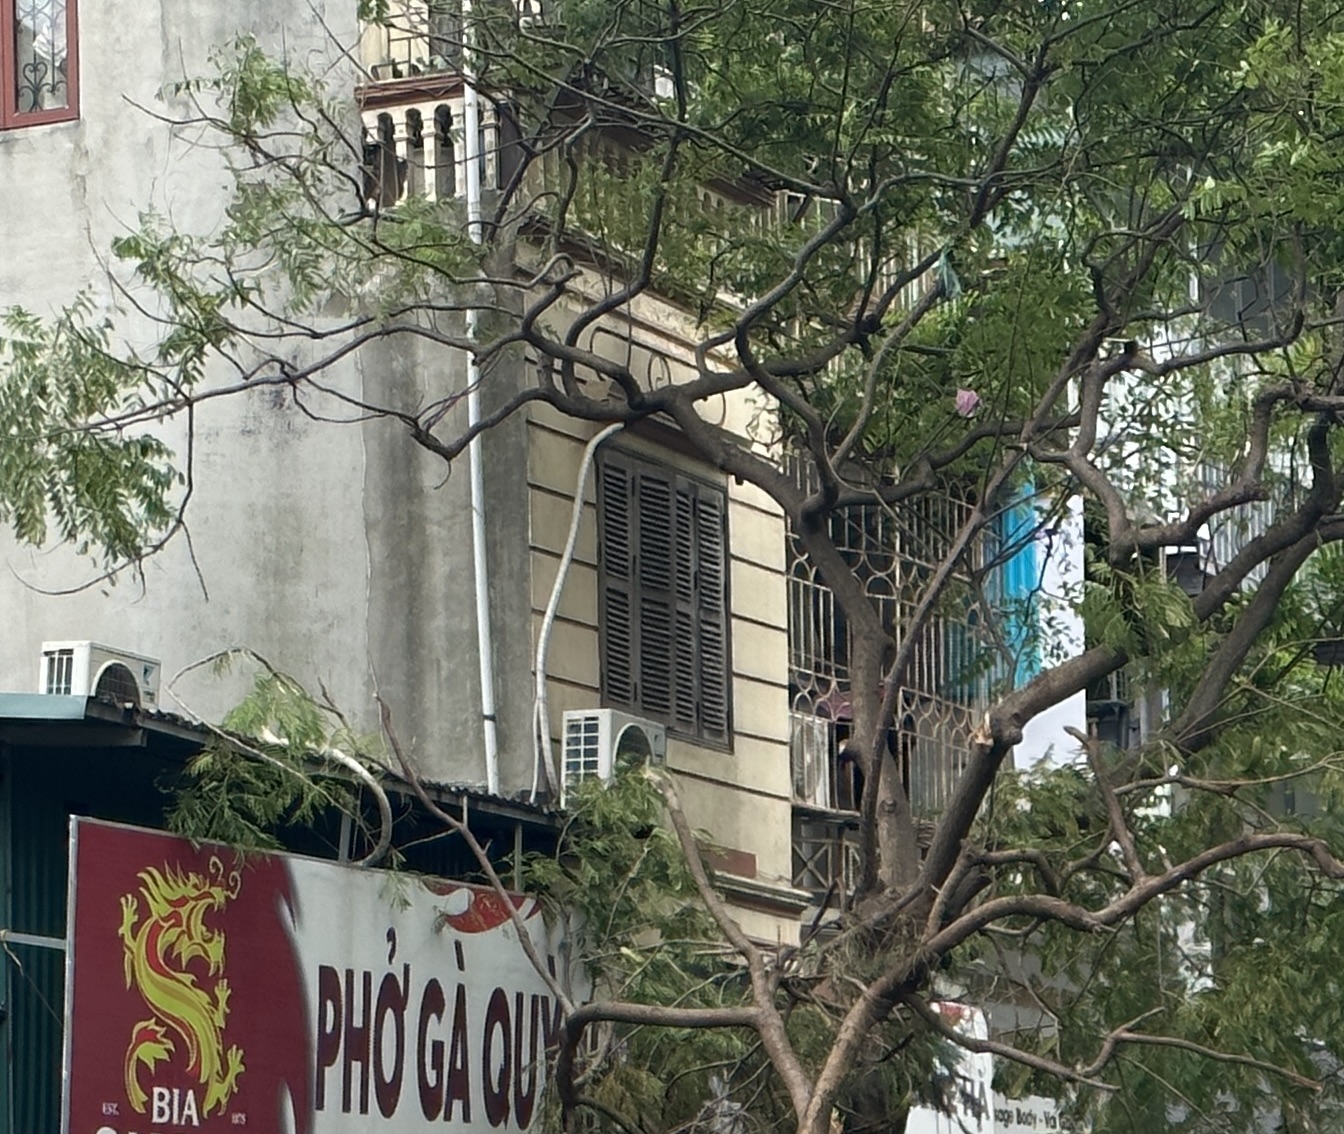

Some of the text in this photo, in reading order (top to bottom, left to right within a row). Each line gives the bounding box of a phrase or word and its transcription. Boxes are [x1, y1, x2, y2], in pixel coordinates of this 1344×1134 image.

[314, 926, 411, 1120] PHỞ
[416, 938, 472, 1124] GÀ
[151, 1086, 200, 1127] BIA
